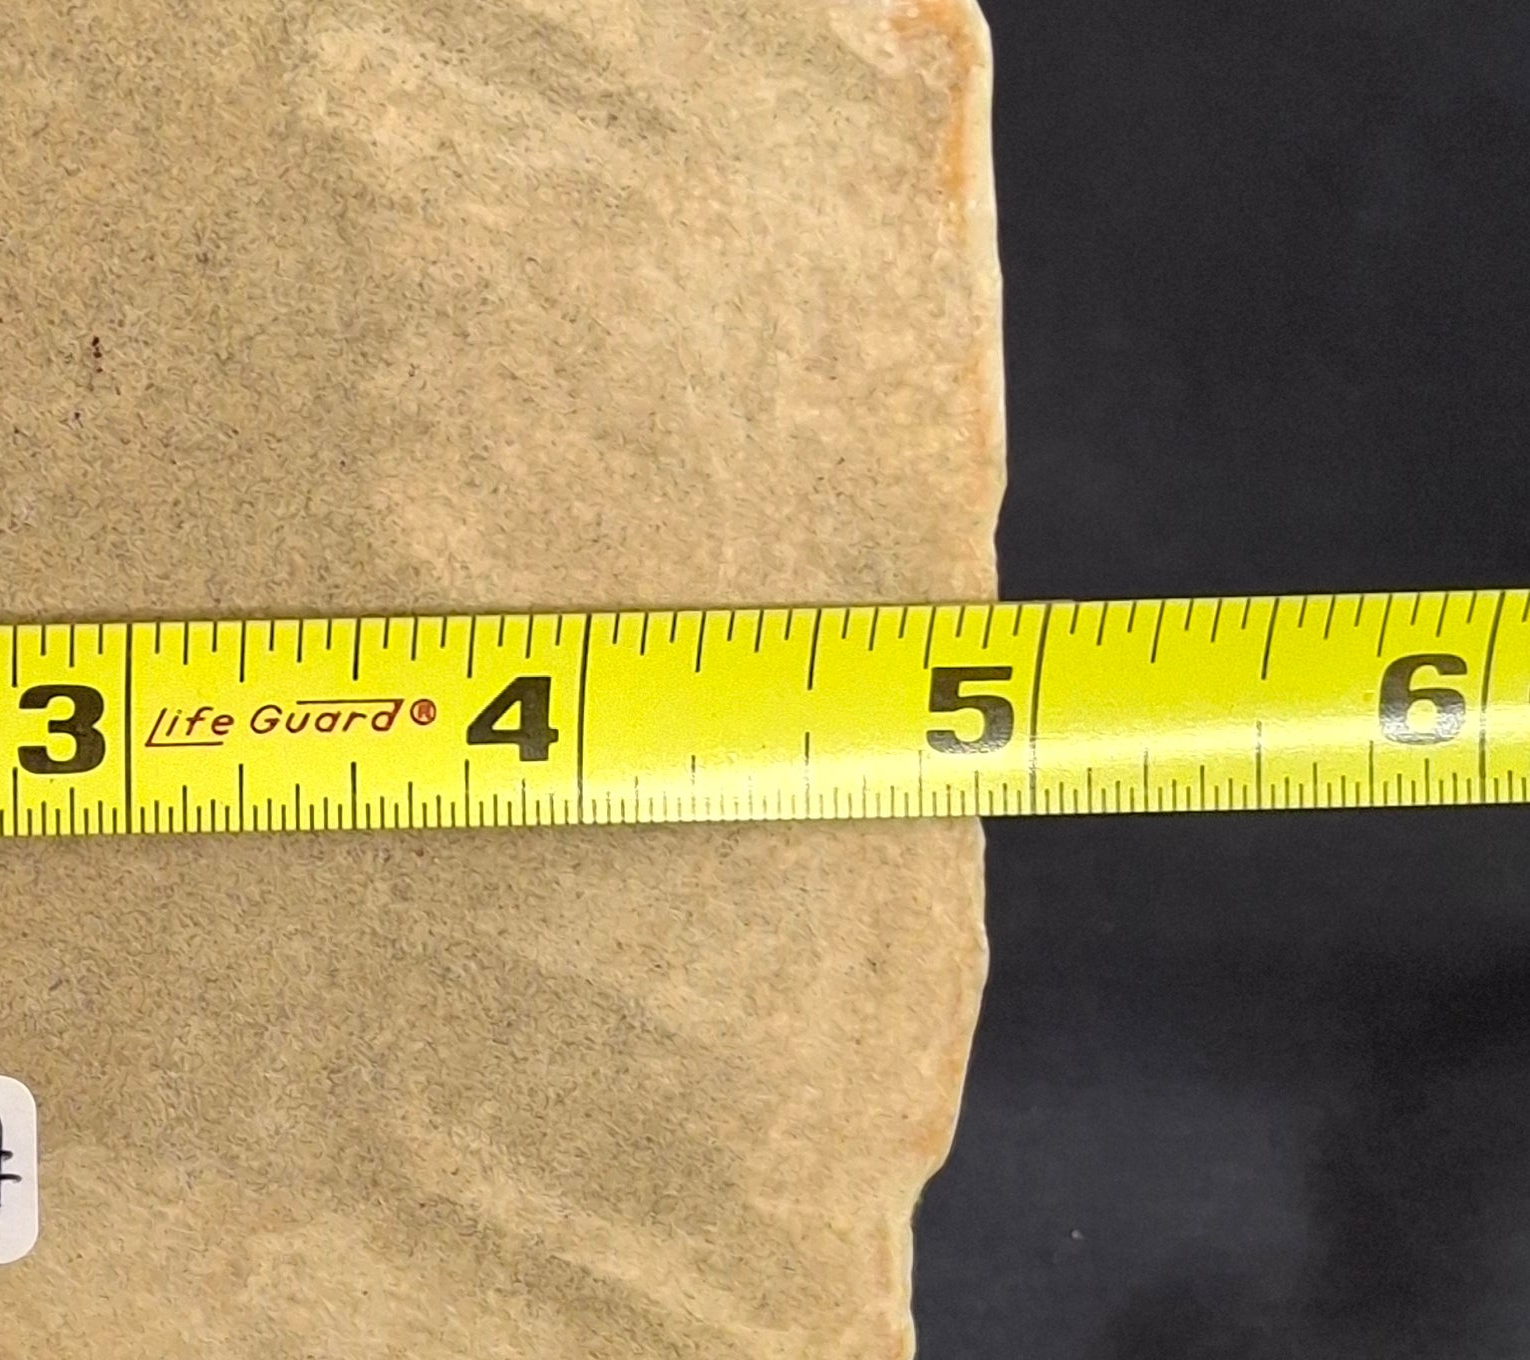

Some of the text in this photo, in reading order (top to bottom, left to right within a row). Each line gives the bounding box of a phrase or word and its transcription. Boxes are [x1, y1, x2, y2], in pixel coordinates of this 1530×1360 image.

[17, 683, 106, 775] 3
[144, 707, 235, 747] Life
[466, 676, 559, 761] 4
[925, 666, 1015, 754] 5
[1378, 653, 1469, 746] 6
